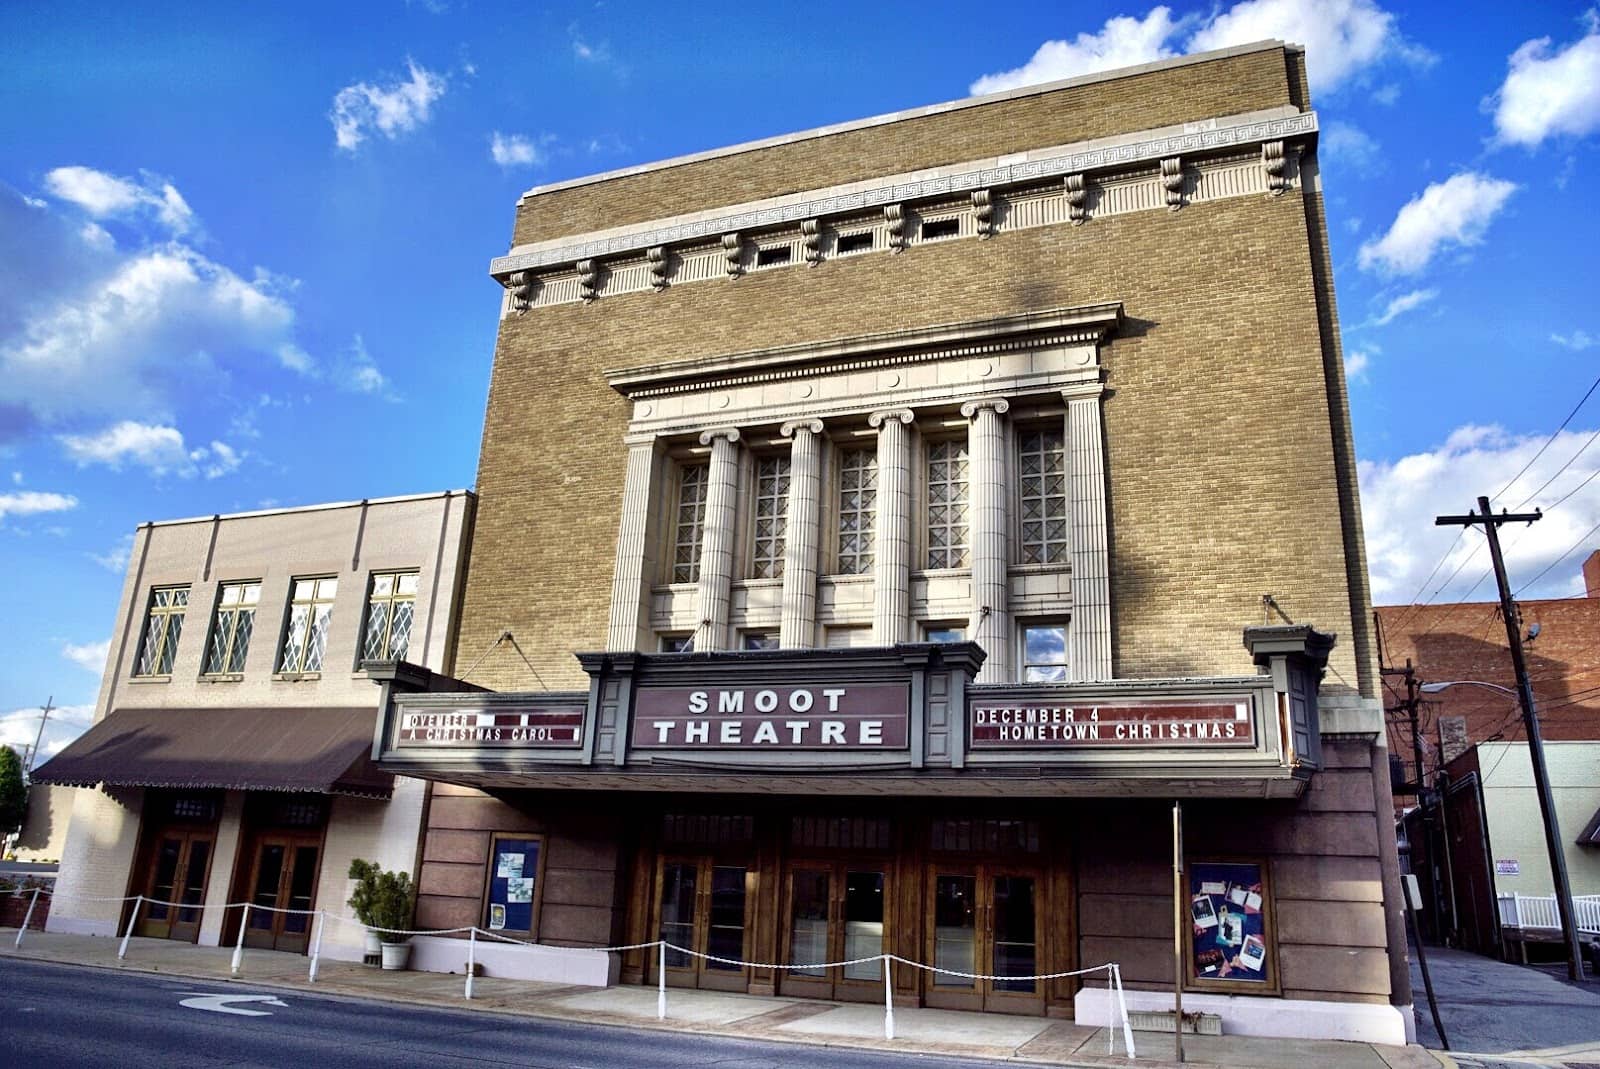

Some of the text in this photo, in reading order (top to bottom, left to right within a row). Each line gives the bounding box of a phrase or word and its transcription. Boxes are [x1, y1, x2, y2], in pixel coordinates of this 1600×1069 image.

[688, 689, 846, 714] SMOOT
[976, 707, 1099, 724] DECEMBER 4
[409, 728, 553, 741] A CHRISTMAS CAROL
[653, 720, 883, 744] THEATRE
[999, 722, 1235, 740] HOMETOWN CHRISTMAS
